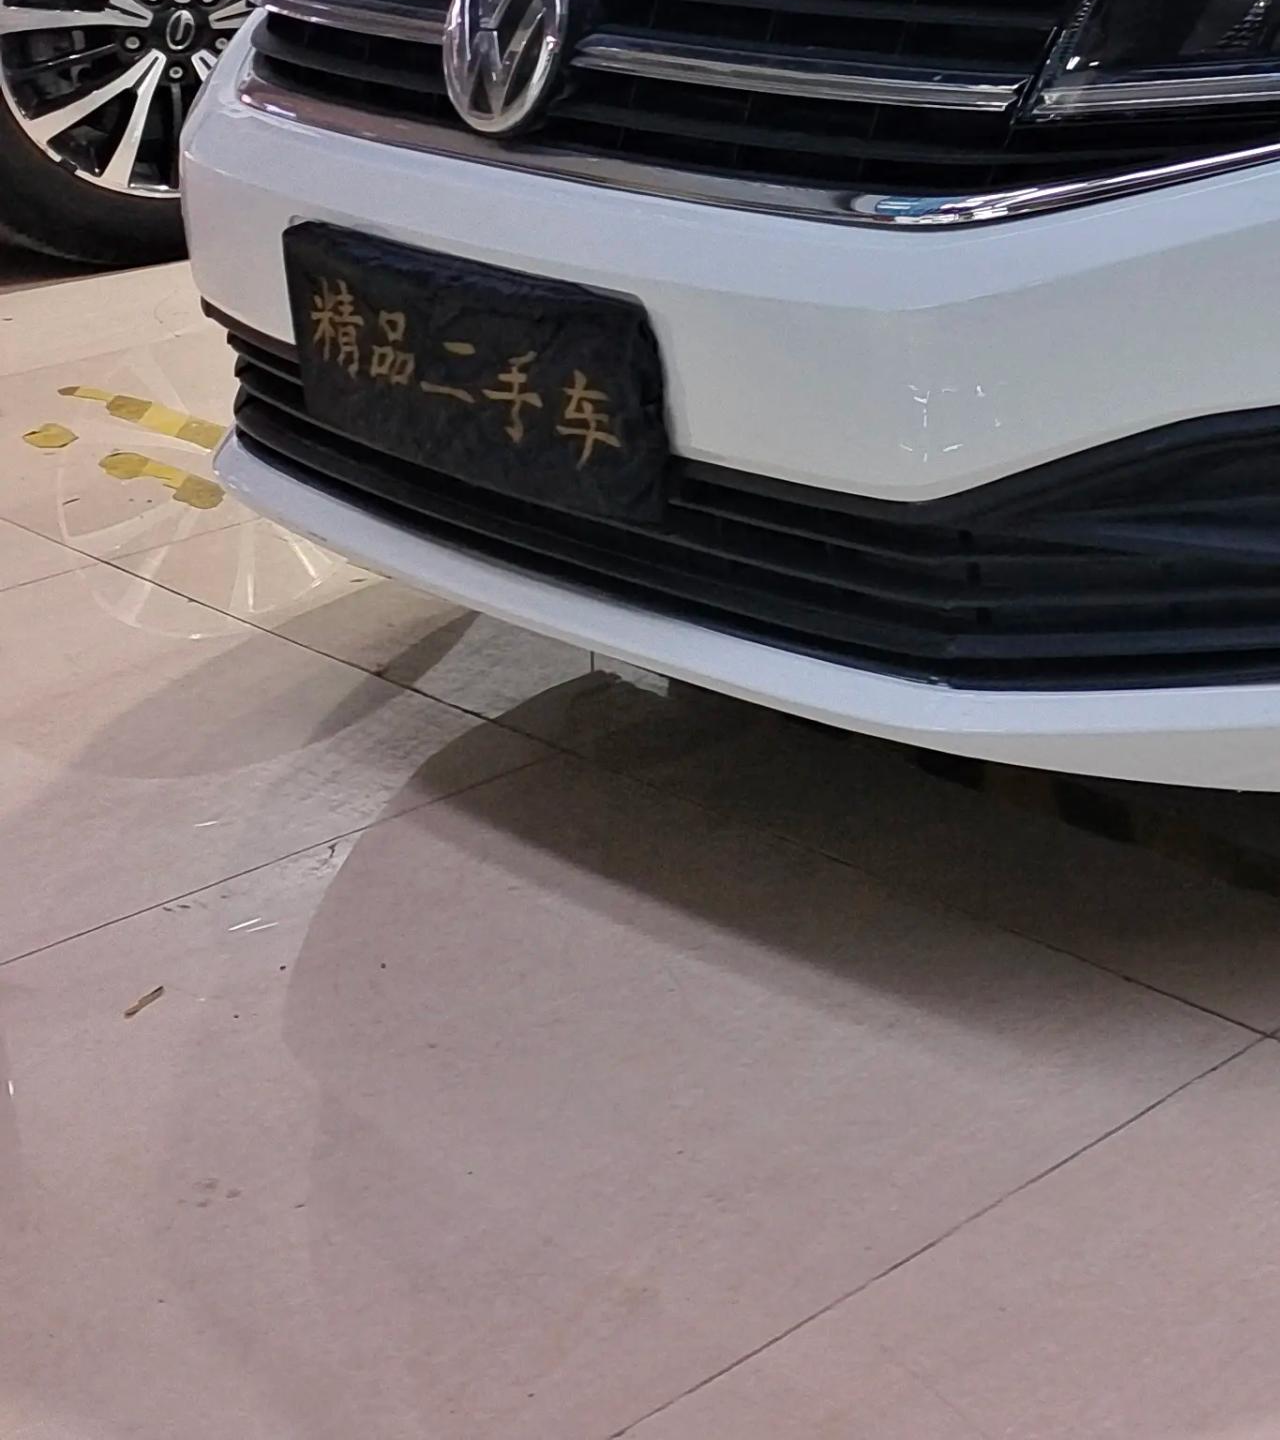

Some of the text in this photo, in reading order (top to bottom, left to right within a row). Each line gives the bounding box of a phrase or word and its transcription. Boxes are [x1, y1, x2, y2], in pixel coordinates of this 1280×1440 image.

[309, 276, 623, 472] 精品二手车
